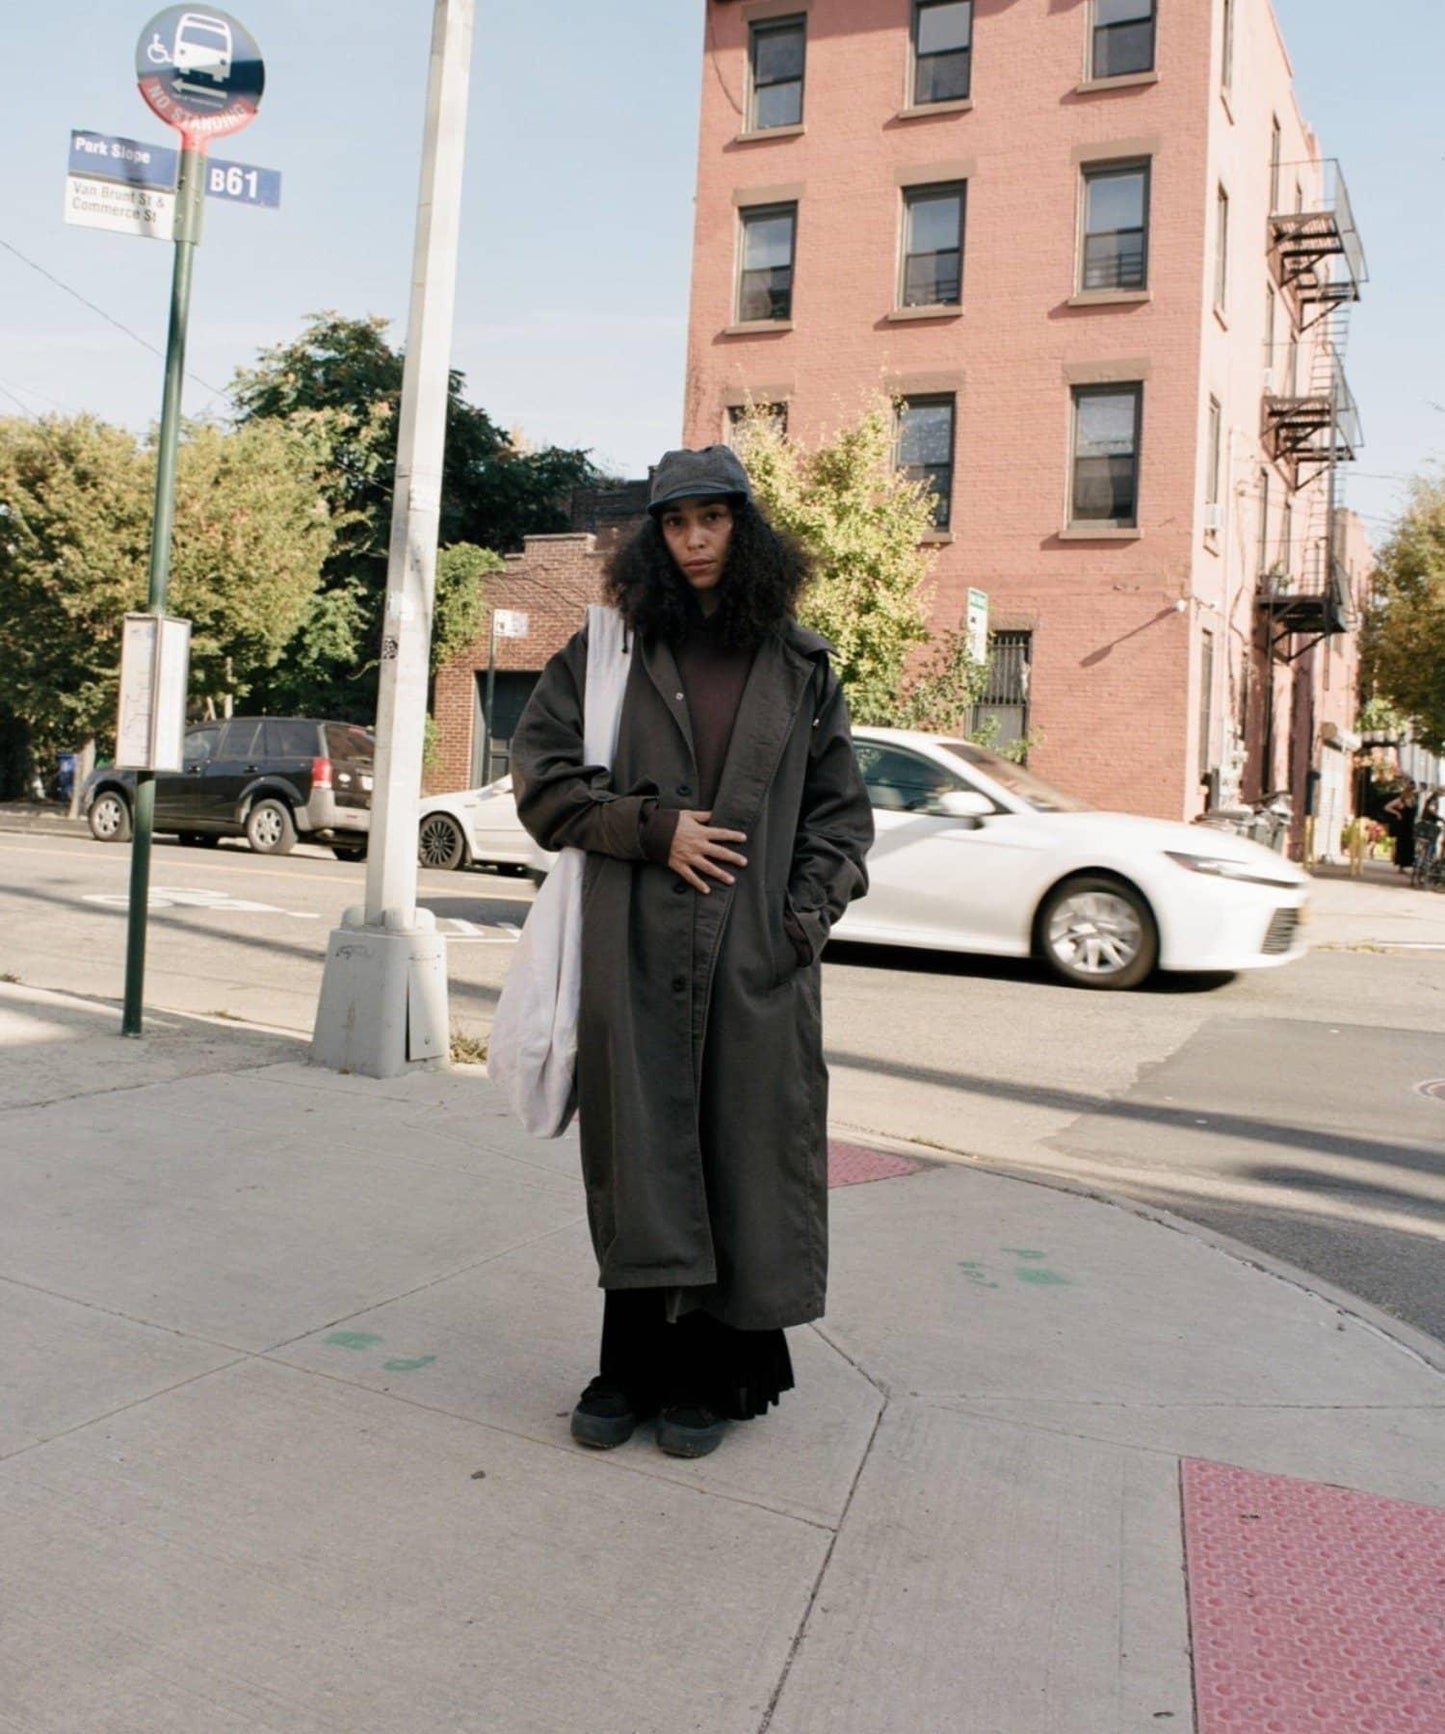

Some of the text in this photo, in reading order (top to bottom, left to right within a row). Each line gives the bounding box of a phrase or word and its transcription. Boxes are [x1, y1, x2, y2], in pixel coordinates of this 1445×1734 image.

[149, 84, 170, 109] NO
[75, 136, 151, 164] Park Slope
[73, 180, 97, 196] Van
[101, 186, 136, 204] Brunt
[209, 167, 258, 198] B61
[72, 196, 157, 223] Commerce St
